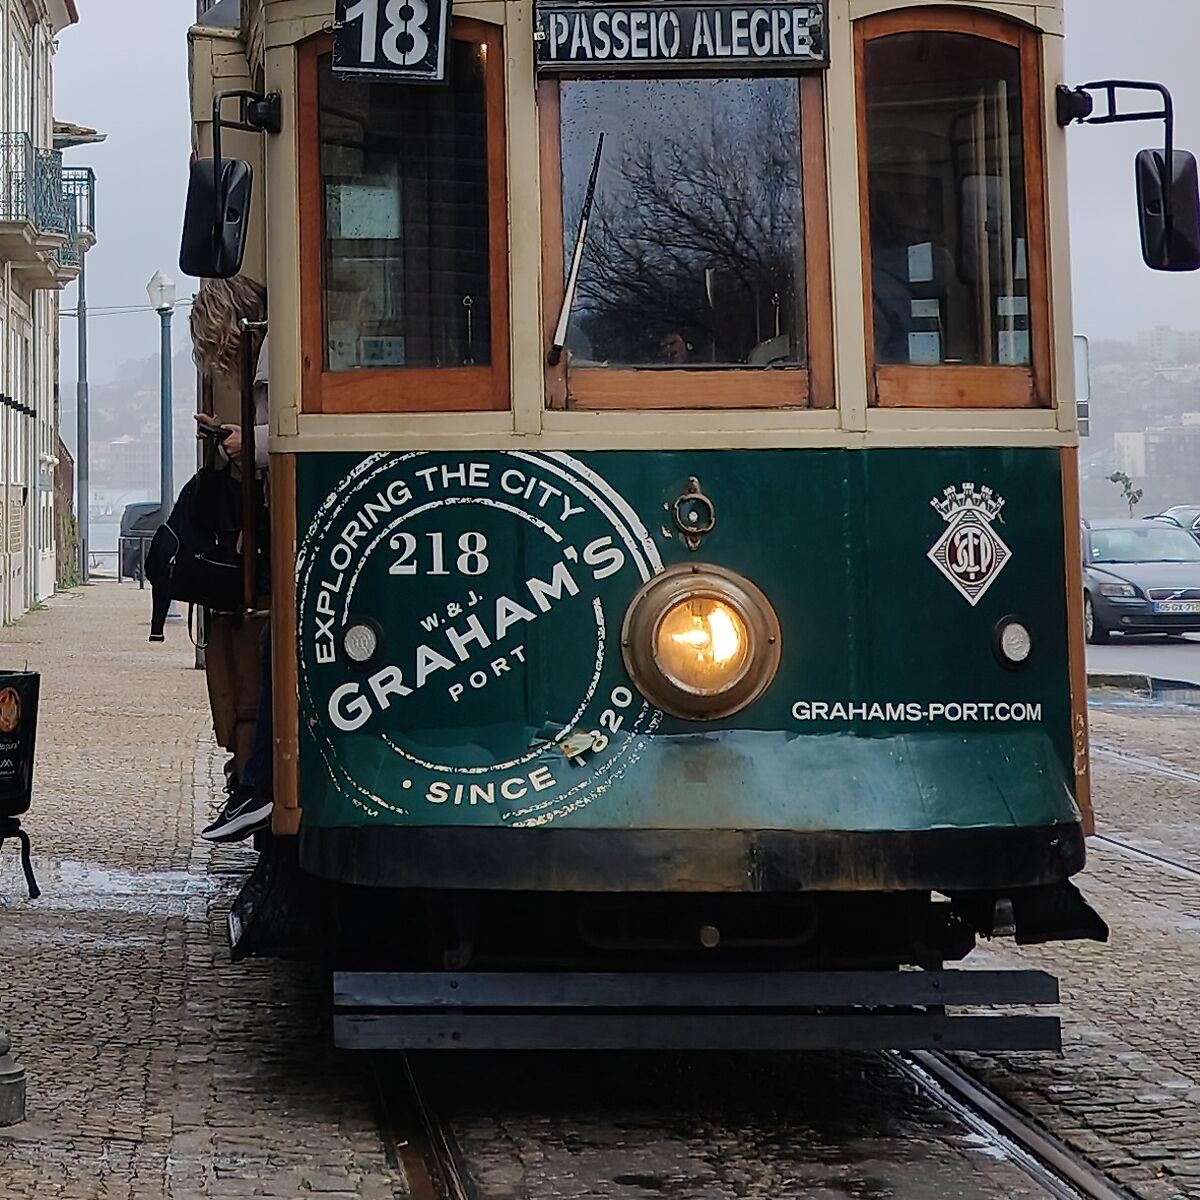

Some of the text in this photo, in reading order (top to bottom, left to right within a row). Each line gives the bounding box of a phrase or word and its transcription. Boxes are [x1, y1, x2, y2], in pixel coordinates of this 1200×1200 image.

[548, 8, 811, 60] PASSEIO ALEGRE
[315, 462, 586, 663] EXPLORING THE CITY
[388, 531, 490, 576] 218
[328, 535, 625, 732] GRAHAM'S
[420, 589, 484, 632] W. & J.
[448, 644, 528, 702] PORT
[791, 701, 1042, 722] GRAHAMS-PORT.COM
[425, 765, 557, 805] SINCE
